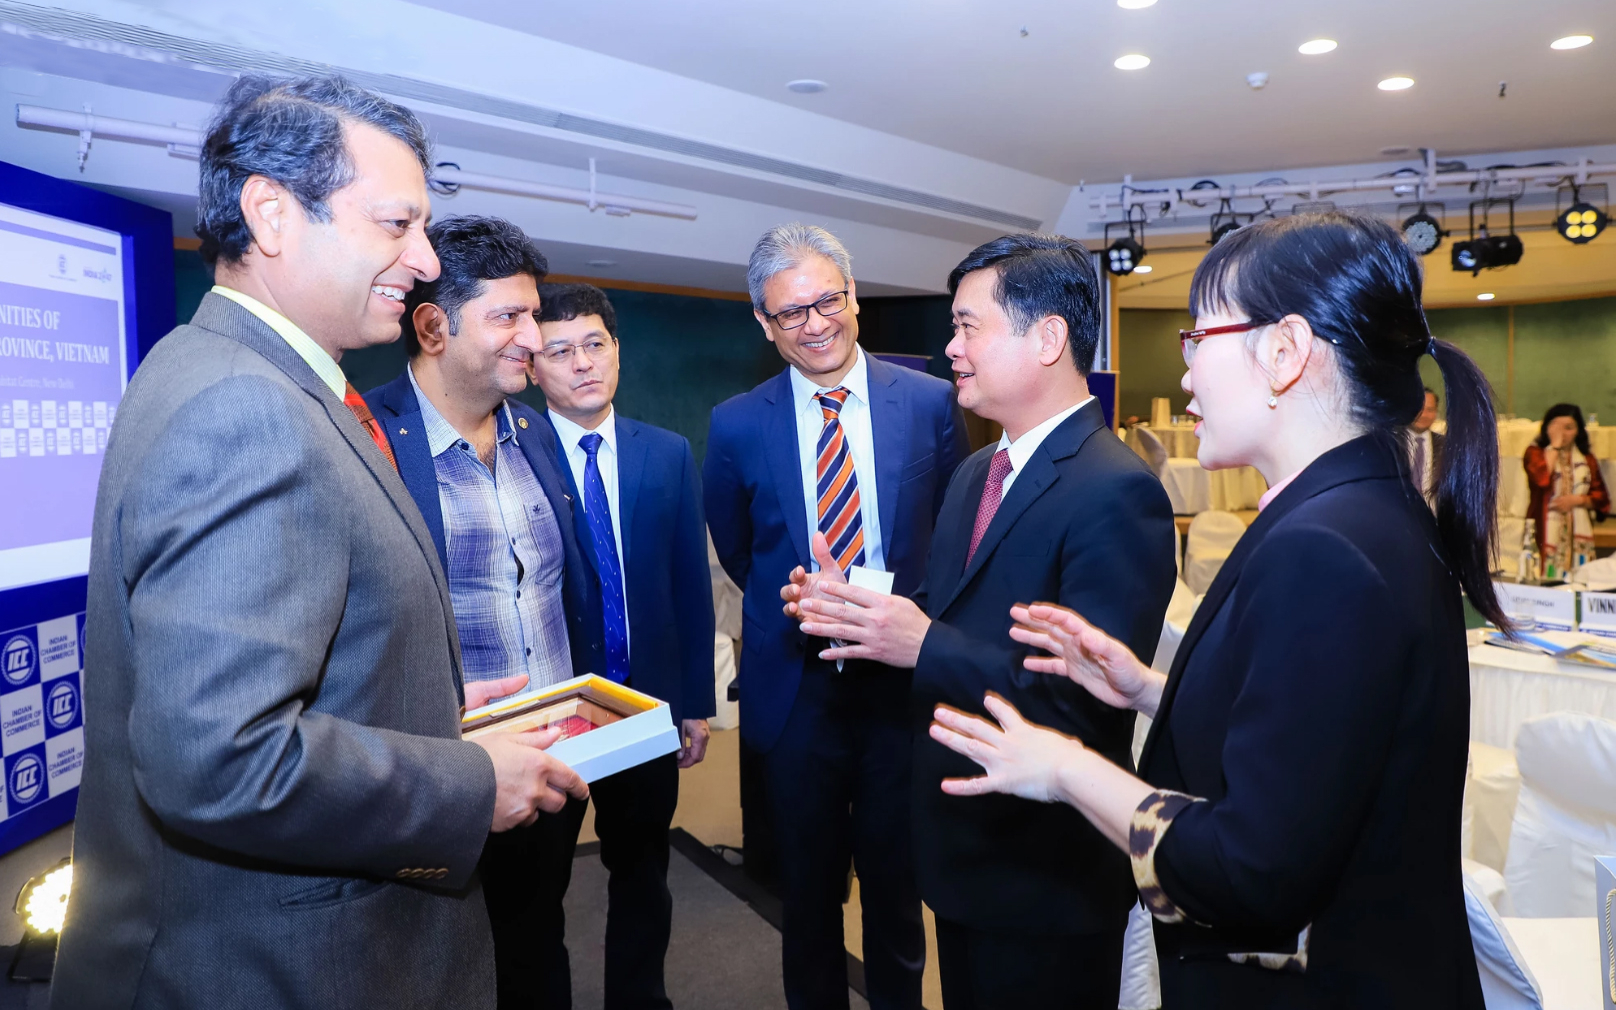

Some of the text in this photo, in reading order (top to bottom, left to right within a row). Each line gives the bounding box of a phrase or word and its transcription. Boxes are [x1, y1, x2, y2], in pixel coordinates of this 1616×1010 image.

[43, 310, 60, 330] OF
[0, 336, 110, 365] OVINCE, VIETNAM
[41, 640, 76, 656] CHAMBER OF
[49, 635, 68, 645] INDIAN
[43, 649, 75, 664] COMMERCE
[2, 709, 42, 729] CHAMBER OF
[12, 705, 32, 717] INDIAN
[6, 719, 40, 737] COMMERCE
[48, 751, 84, 771] CHAMBER OF
[57, 747, 75, 759] INDIAN
[51, 760, 82, 779] COMMERCE
